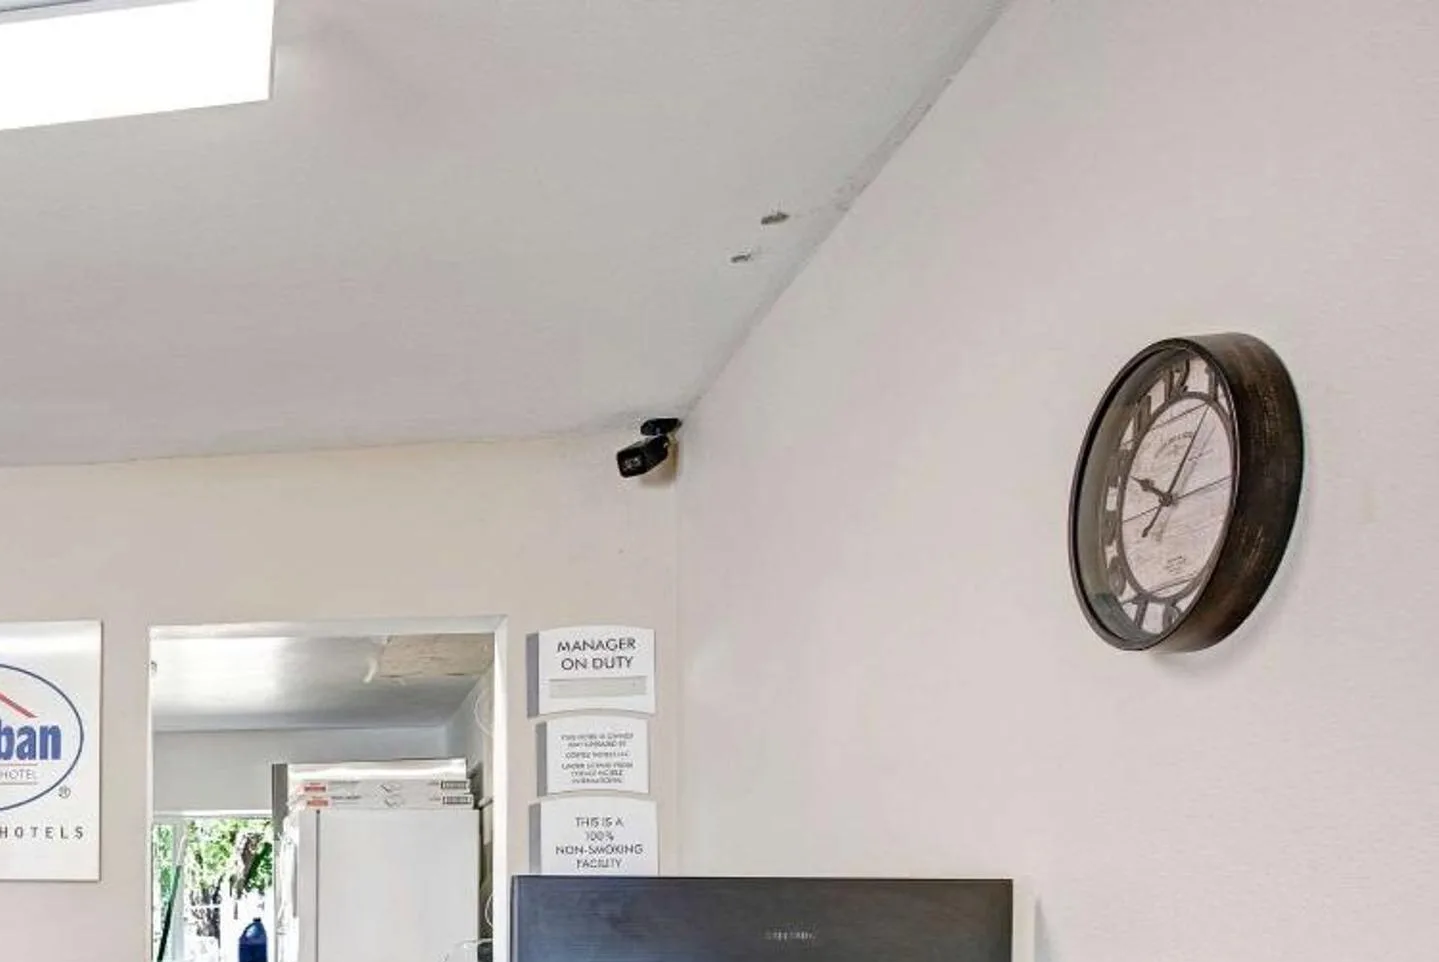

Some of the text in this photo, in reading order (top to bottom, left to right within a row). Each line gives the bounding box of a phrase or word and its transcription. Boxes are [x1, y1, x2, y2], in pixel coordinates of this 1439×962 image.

[556, 637, 636, 653] MANAGER
[561, 655, 634, 670] ON DUTY
[575, 816, 624, 828] THIS IS A
[585, 830, 615, 842] 100%
[555, 843, 644, 855] NON-SMOKING
[576, 857, 622, 870] FACILITY
